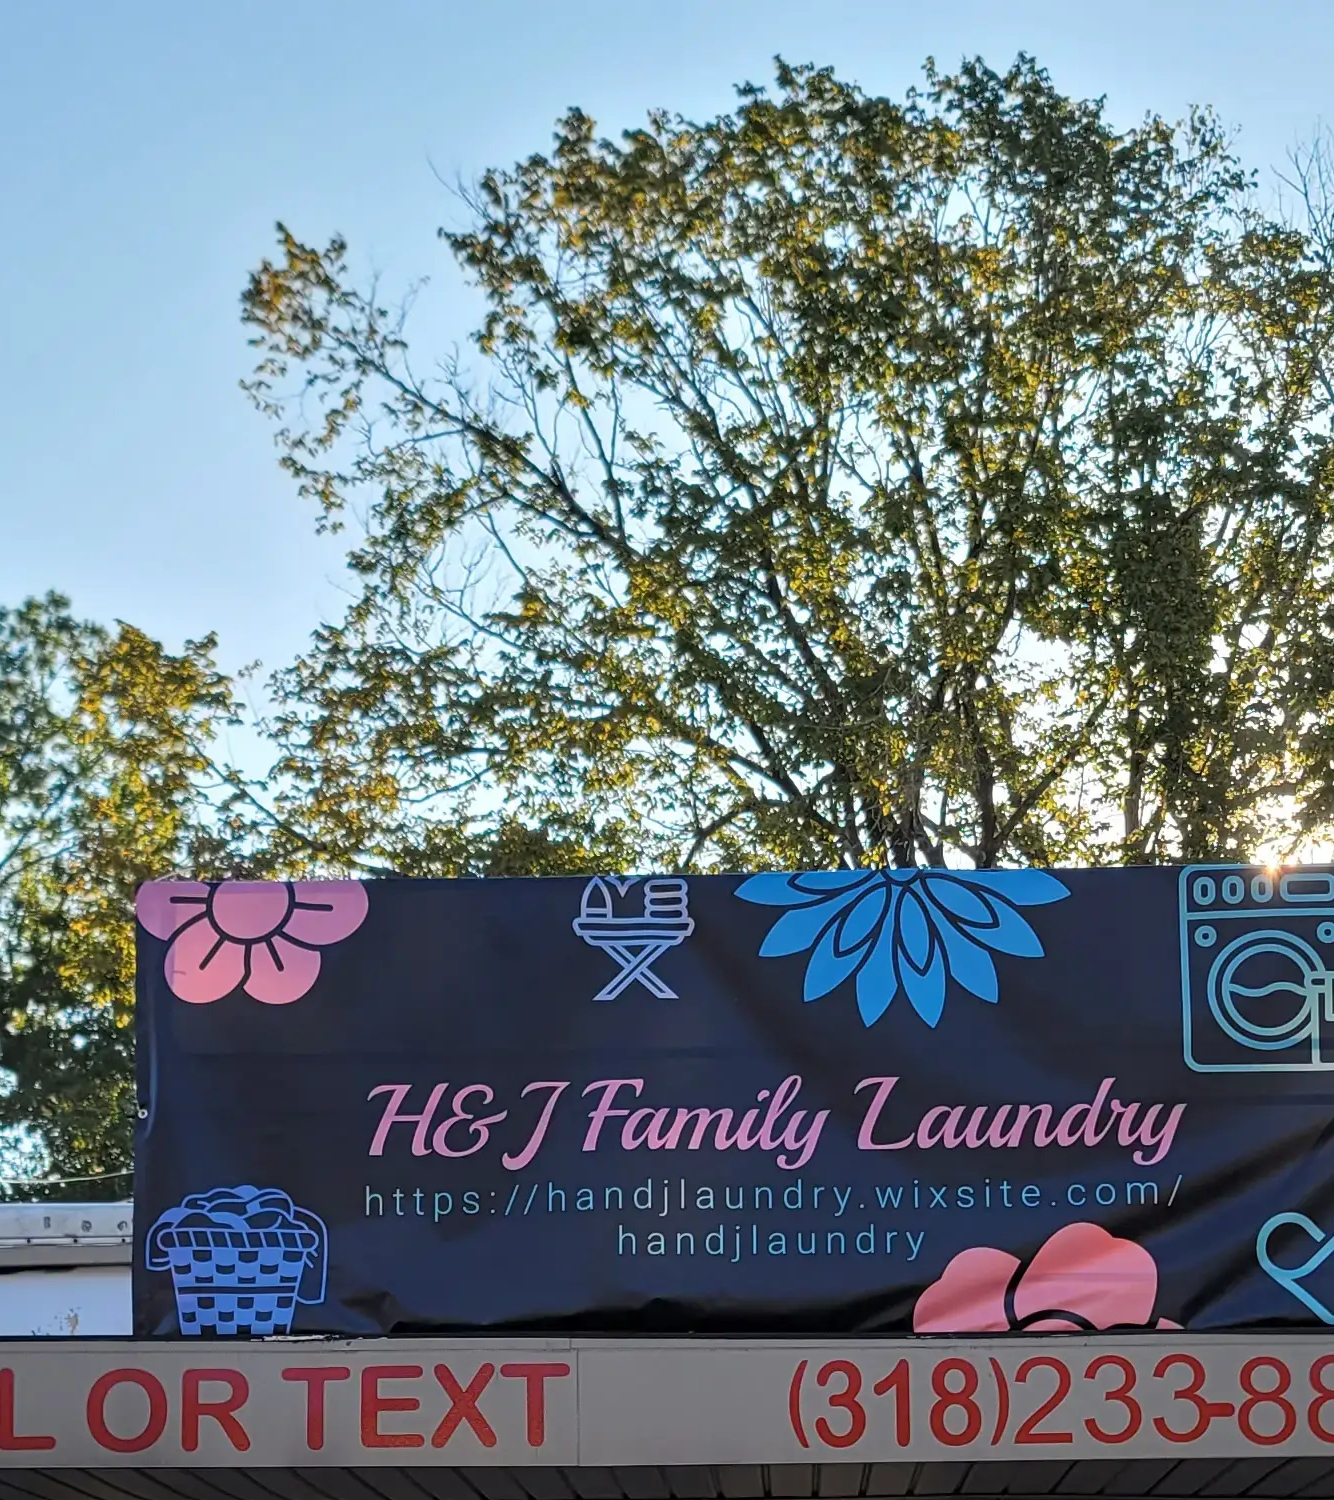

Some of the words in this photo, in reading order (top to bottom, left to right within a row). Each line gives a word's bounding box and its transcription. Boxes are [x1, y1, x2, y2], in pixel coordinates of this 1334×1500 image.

[367, 1081, 571, 1171] H&J
[581, 1074, 831, 1170] Family
[853, 1075, 1188, 1166] Laundry
[365, 1174, 1183, 1223] https://handjlaundry.wixsite.com/
[618, 1224, 925, 1263] handjlaundry
[85, 1367, 252, 1453] OR
[281, 1361, 572, 1451] TEXT
